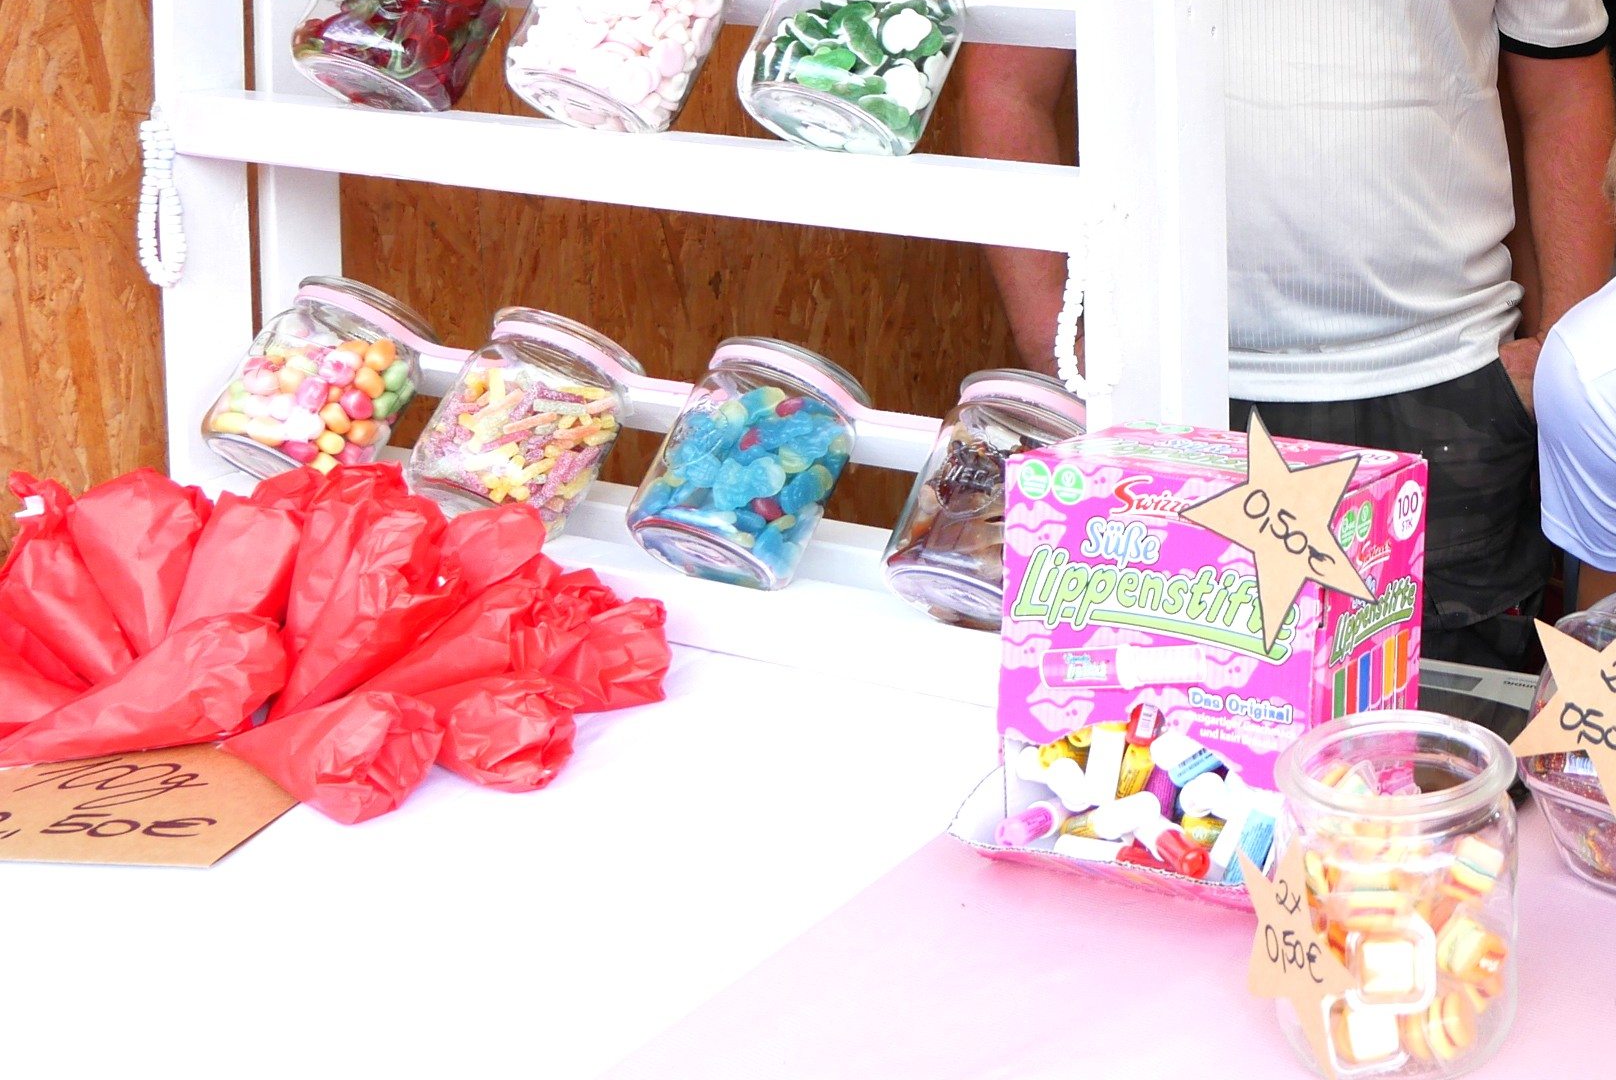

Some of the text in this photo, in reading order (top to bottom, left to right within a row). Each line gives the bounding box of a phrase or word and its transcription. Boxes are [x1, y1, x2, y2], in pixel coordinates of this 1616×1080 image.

[1398, 491, 1419, 519] 100
[1083, 519, 1160, 565] Süße
[1012, 546, 1300, 643] Lippenstife
[1275, 878, 1302, 915] 2x
[1263, 923, 1325, 985] 0,50€
